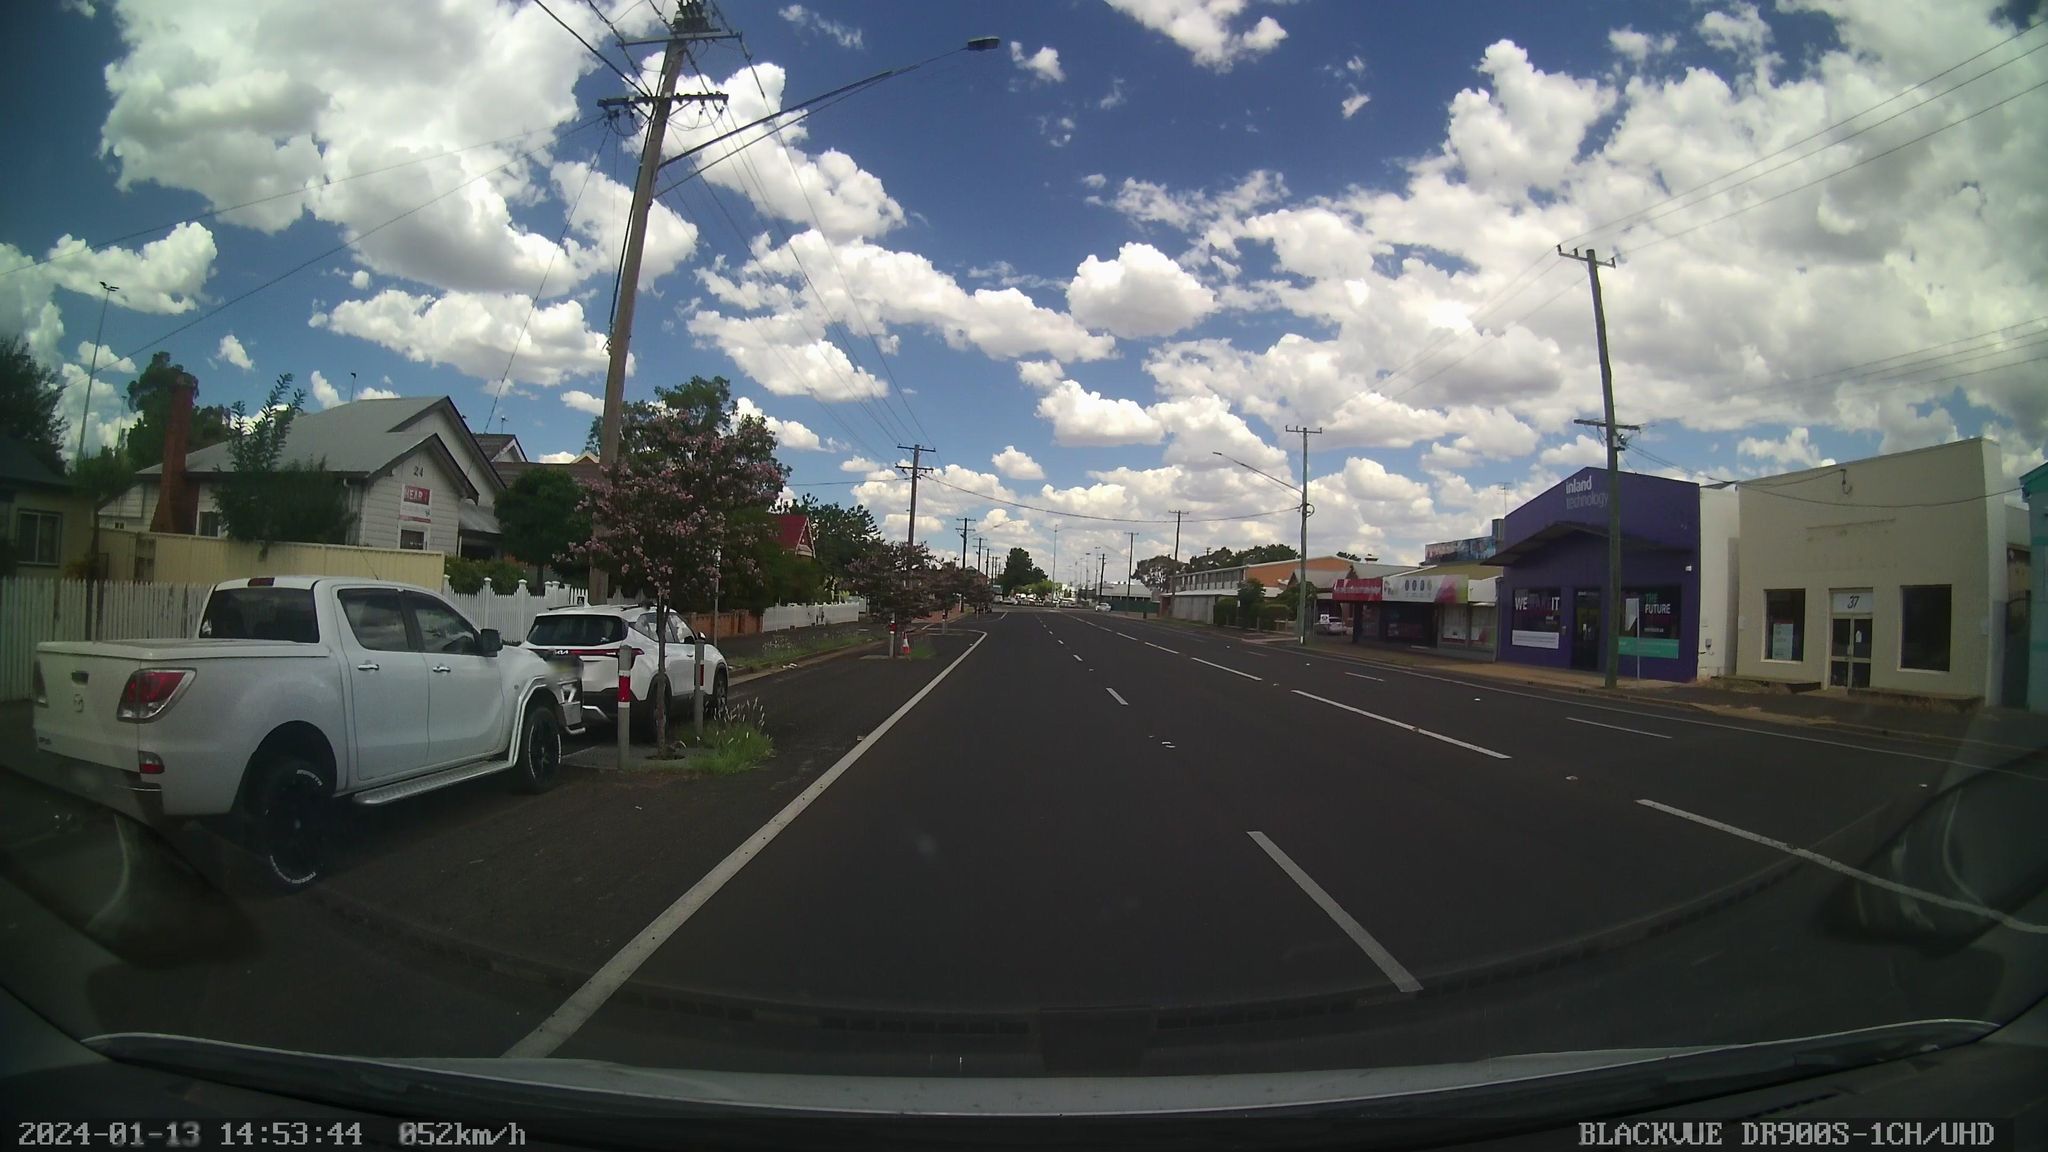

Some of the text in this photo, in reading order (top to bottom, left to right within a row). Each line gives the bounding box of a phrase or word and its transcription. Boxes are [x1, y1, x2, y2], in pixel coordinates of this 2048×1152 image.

[413, 466, 424, 477] 24
[1566, 475, 1592, 494] inland
[1567, 490, 1608, 510] technology
[1515, 596, 1528, 611] WE
[1551, 596, 1560, 611] IT
[1645, 603, 1671, 615] FUTURE
[1847, 595, 1860, 609] 37
